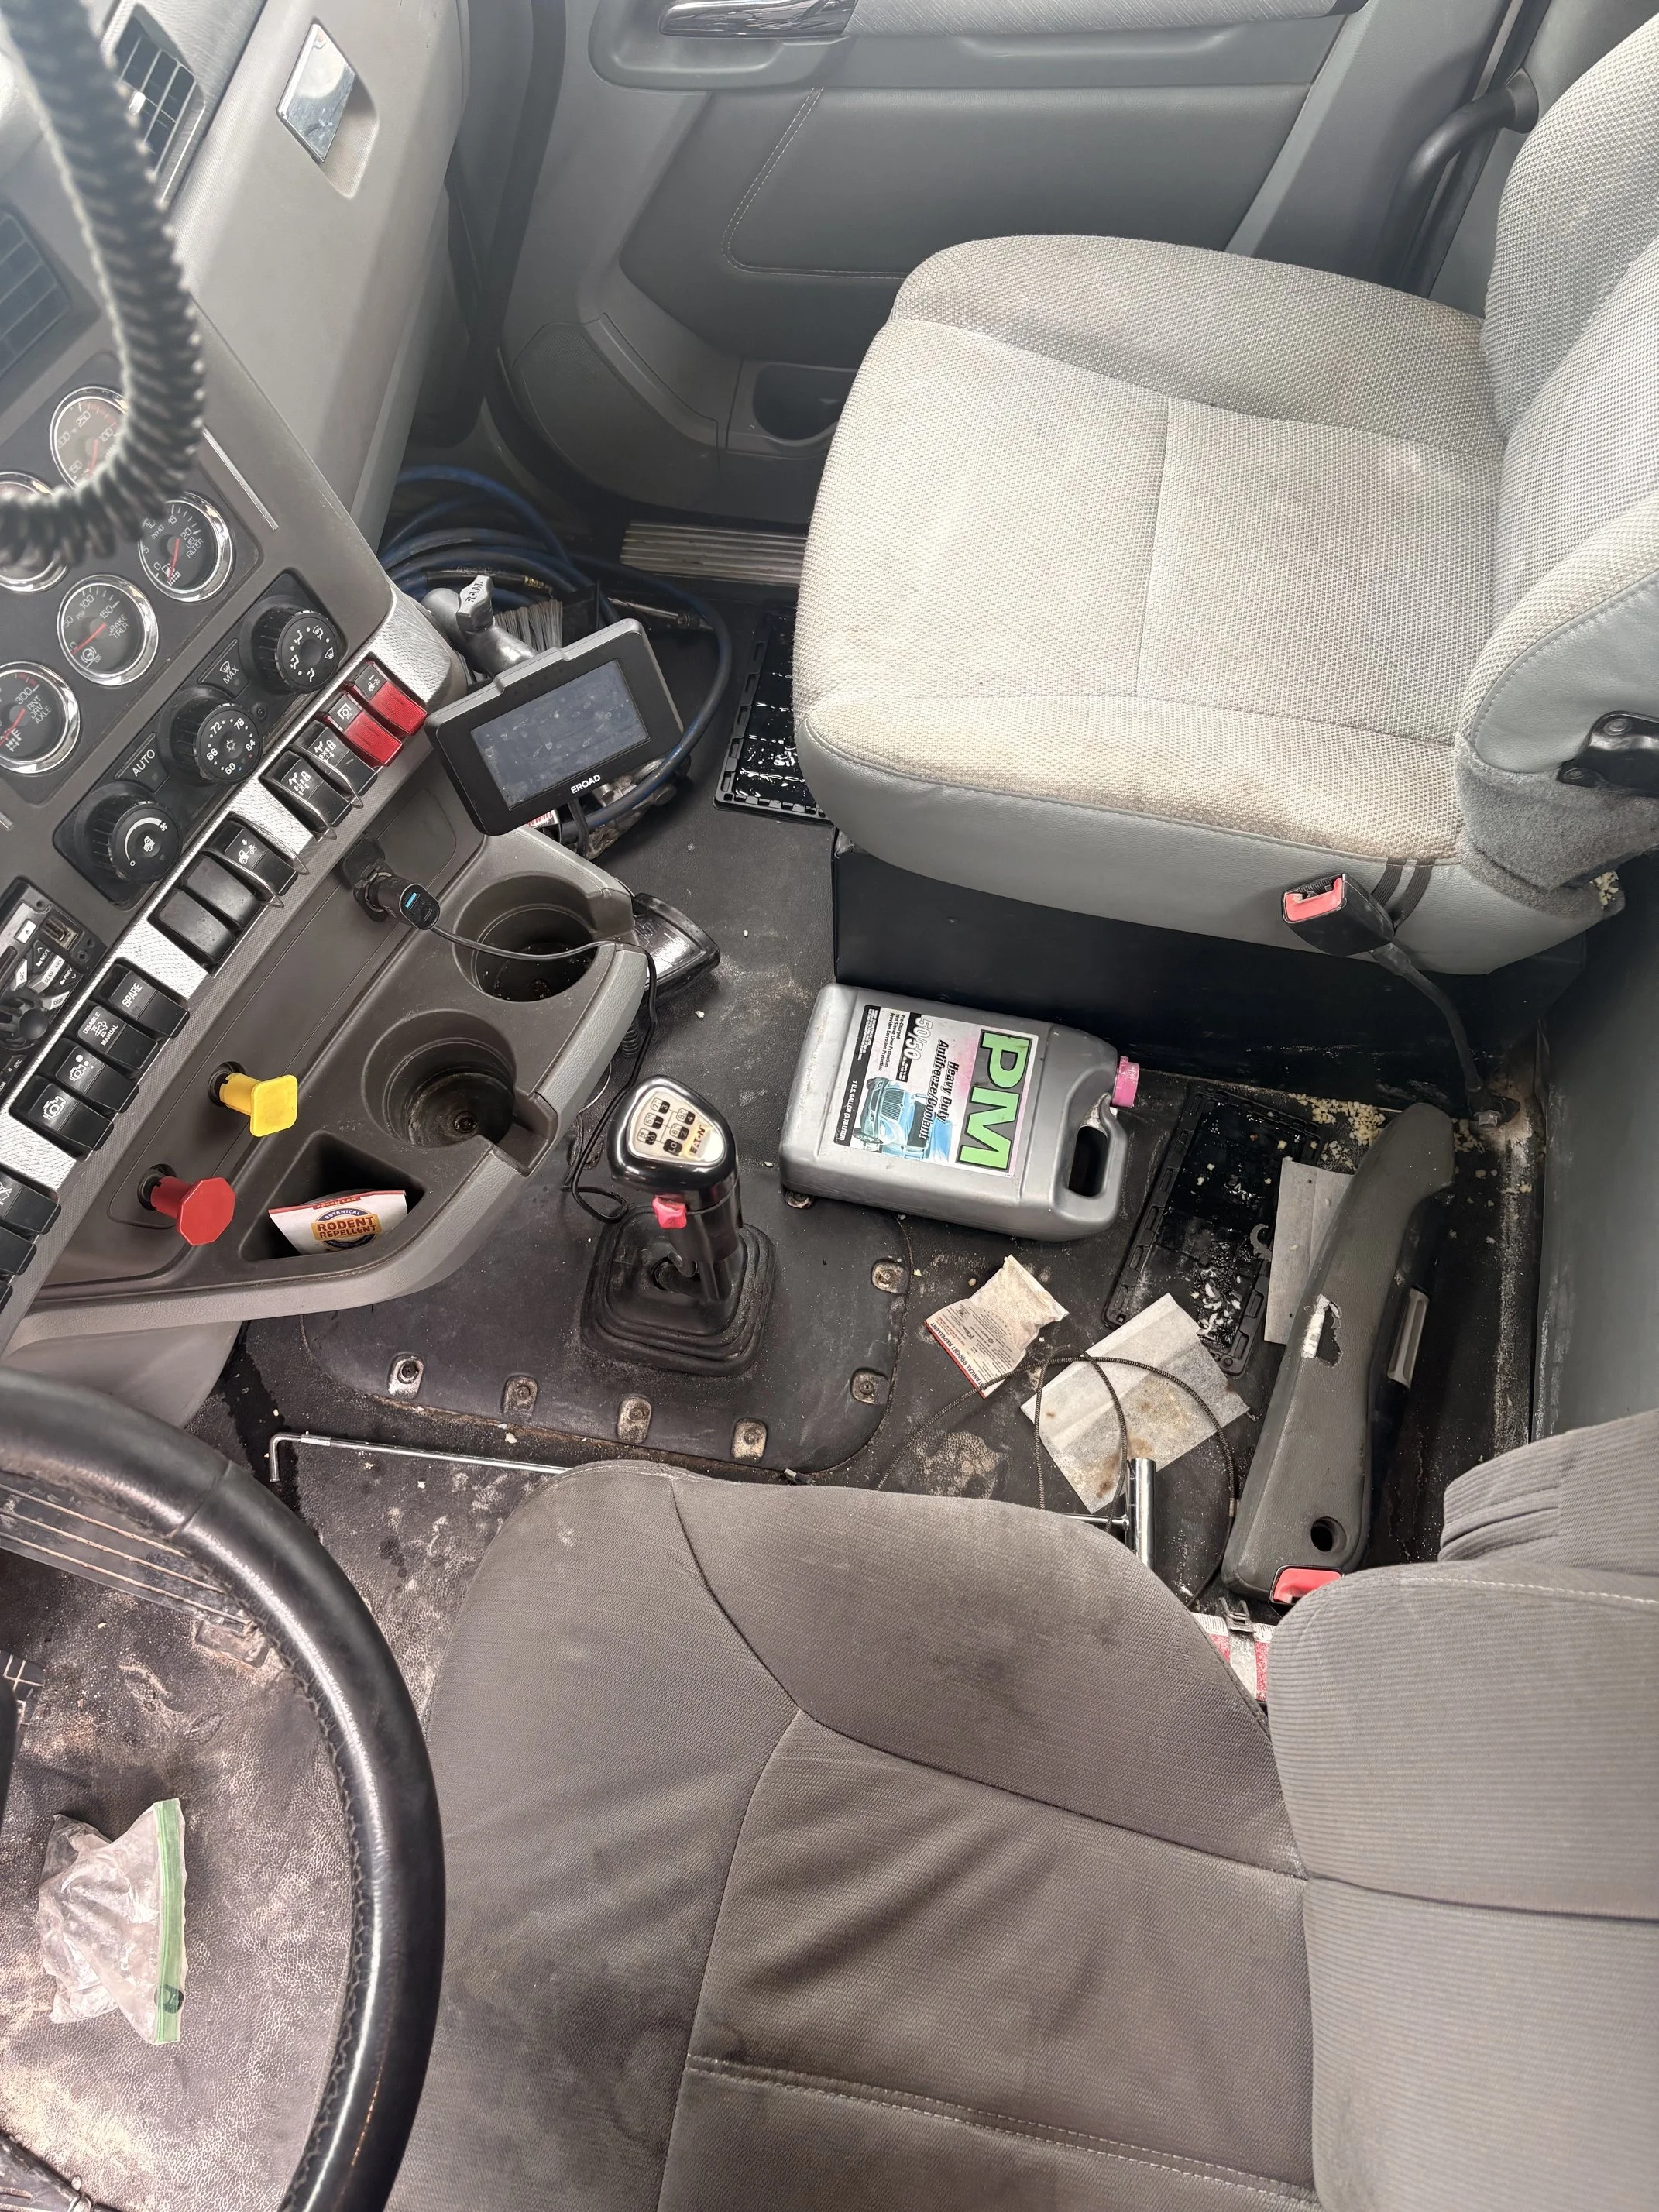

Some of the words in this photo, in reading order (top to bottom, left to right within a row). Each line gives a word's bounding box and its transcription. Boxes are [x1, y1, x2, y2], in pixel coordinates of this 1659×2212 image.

[167, 515, 177, 525] 15
[180, 527, 192, 540] 20
[186, 538, 204, 558] FILTER
[153, 562, 161, 572] 0
[465, 582, 483, 603] RAM
[80, 594, 94, 610] 100
[99, 605, 113, 619] 150
[113, 623, 129, 639] TRLR
[222, 665, 239, 684] MAX
[15, 687, 33, 704] 300
[35, 706, 52, 724] AXLE
[210, 722, 222, 735] 72
[234, 717, 245, 731] 78
[206, 747, 218, 761] 66
[245, 739, 256, 752] 84
[132, 749, 156, 777] AUTO
[225, 762, 236, 775] 60
[570, 775, 601, 794] EROAD
[40, 949, 50, 961] NEXT
[44, 971, 54, 983] SCAN
[64, 967, 73, 981] PREV
[122, 982, 143, 1008] SPARE
[82, 1011, 101, 1035] DISABLE
[896, 1015, 905, 1039] Pre-Charged
[101, 1025, 118, 1046] MANUAL
[882, 1030, 891, 1053] Corrosion
[904, 1017, 933, 1060] 50/50
[878, 1049, 887, 1071] Protection
[941, 1061, 960, 1097] Heavy
[919, 1039, 950, 1140] Antifreeze/Coolant
[846, 1094, 855, 1113] GALLON
[960, 1032, 1030, 1170] PM
[935, 1096, 953, 1124] Duty
[837, 1125, 847, 1141] LITER)
[668, 1142, 678, 1153] LO
[325, 1209, 360, 1220] BOTANICAL
[317, 1216, 373, 1231] RODENT
[319, 1224, 376, 1238] REPELLENT
[930, 1322, 953, 1349] REPELLENT
[951, 1347, 968, 1366] RODENT
